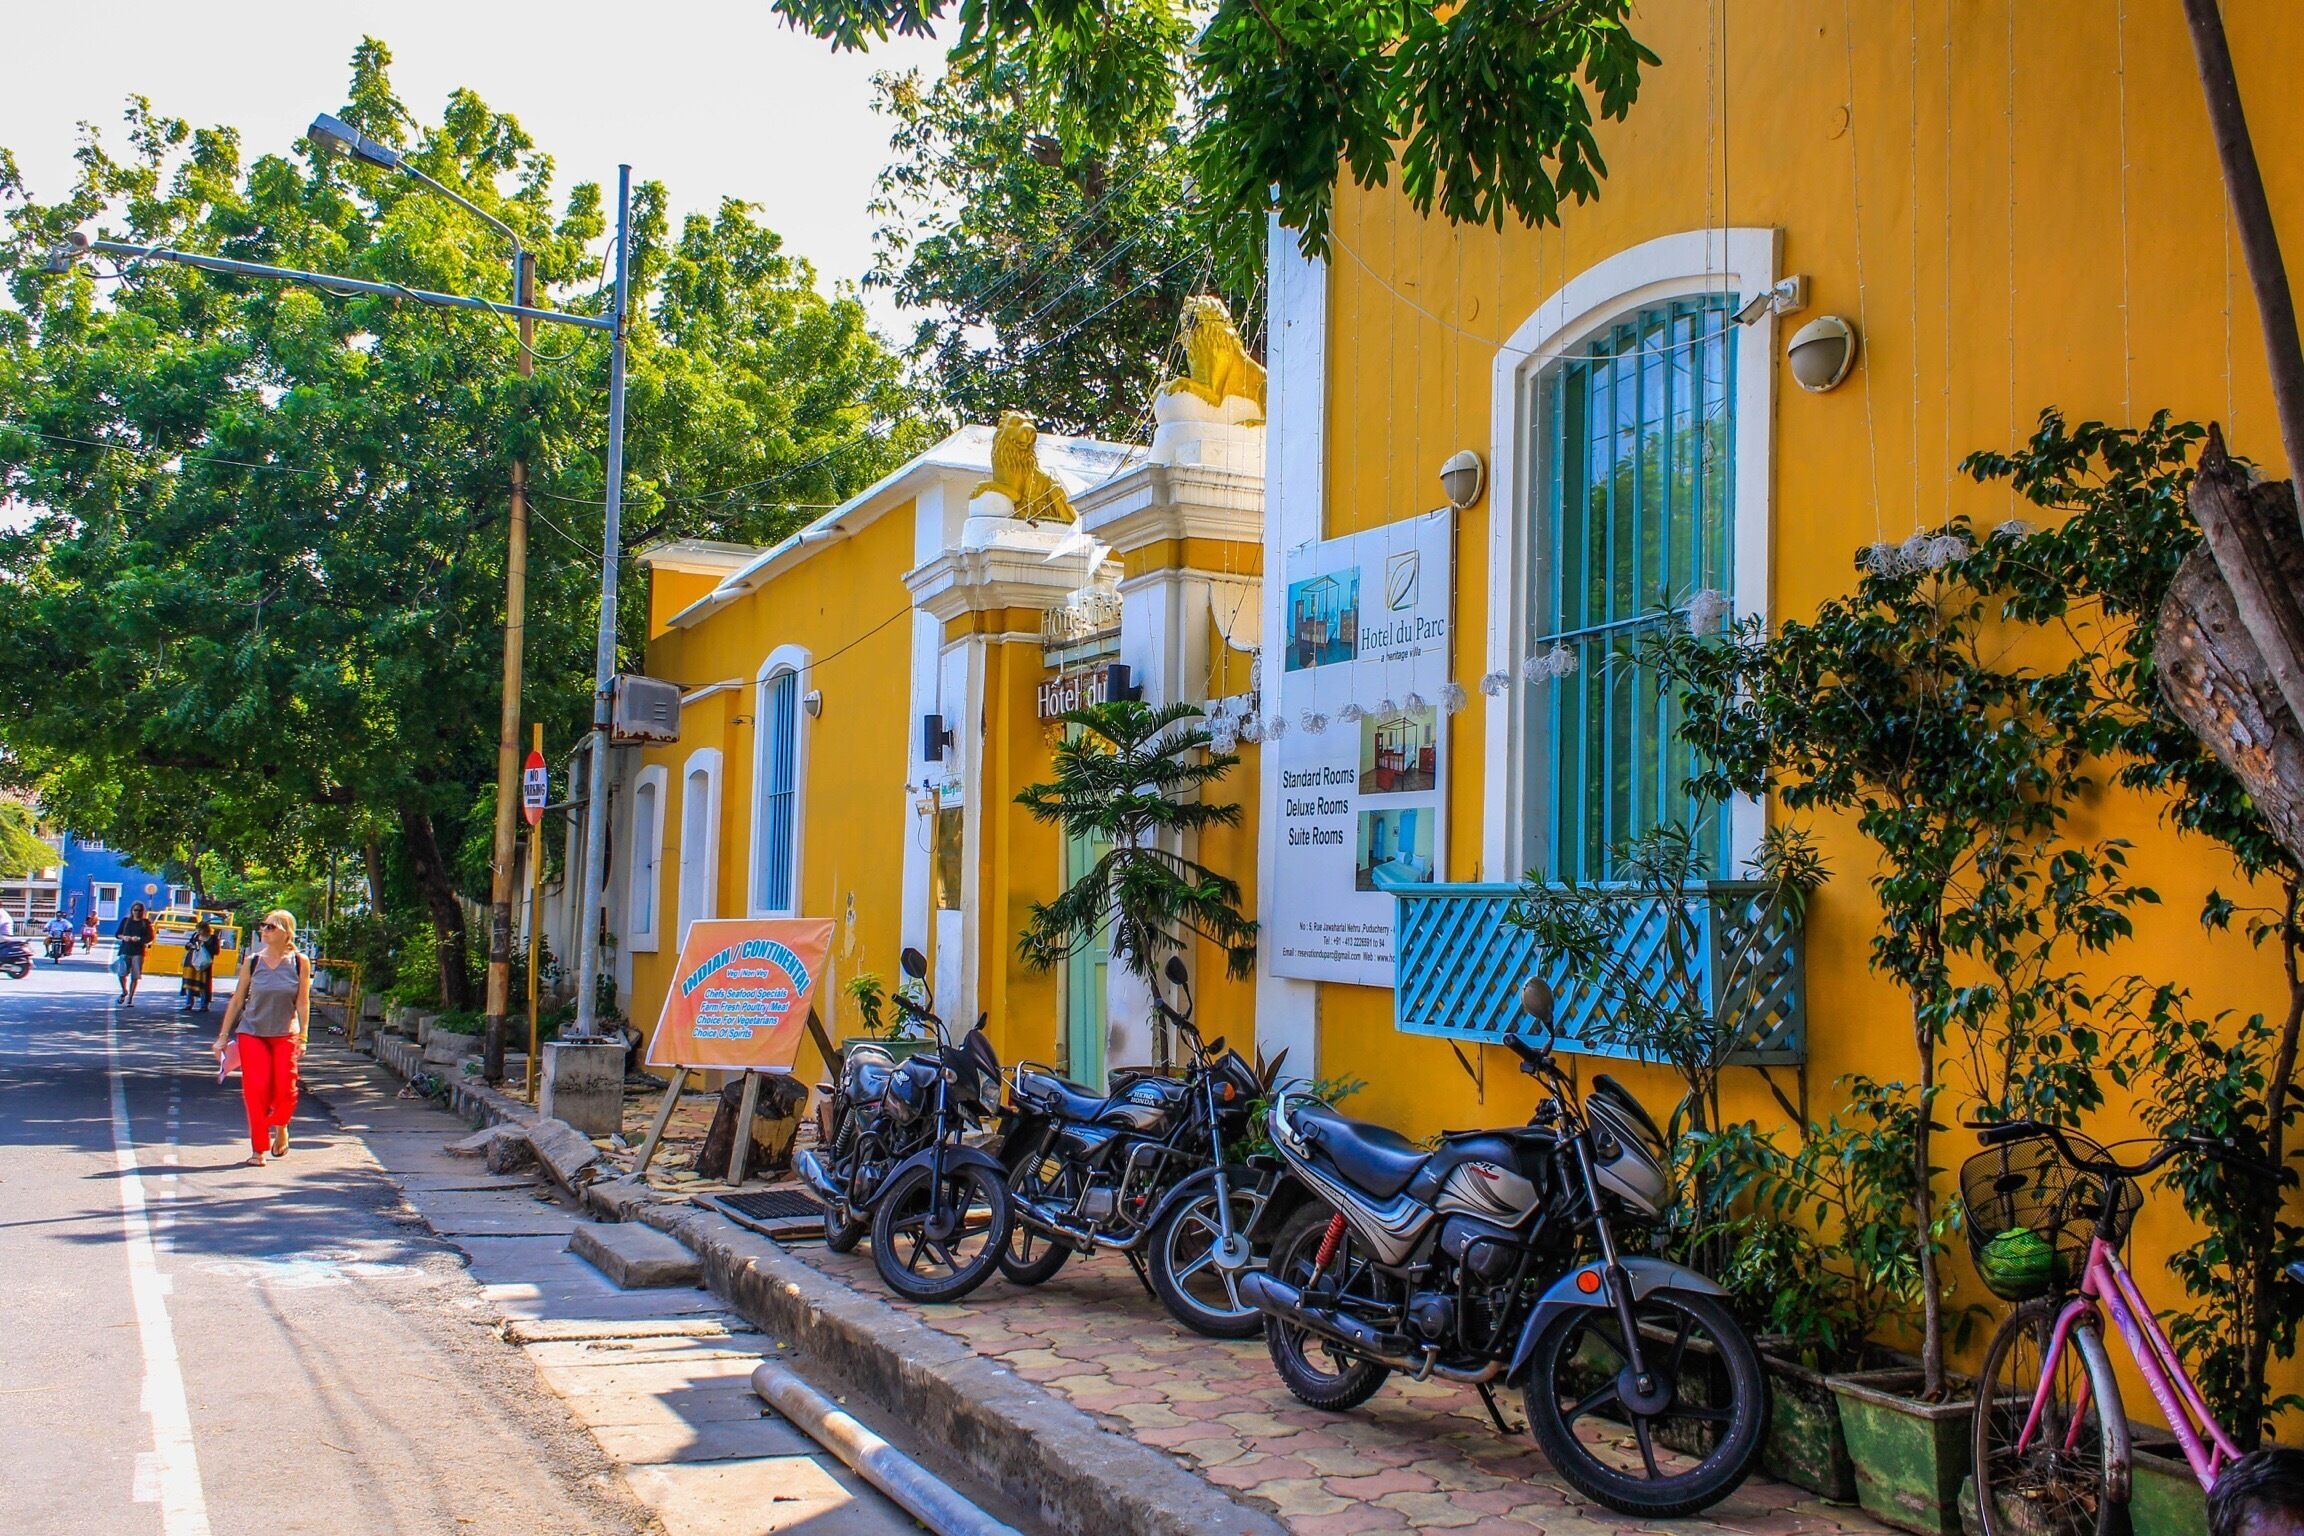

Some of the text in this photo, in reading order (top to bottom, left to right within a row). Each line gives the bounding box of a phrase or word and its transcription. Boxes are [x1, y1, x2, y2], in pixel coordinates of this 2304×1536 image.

[1361, 617, 1445, 651] Hotel du Parc
[1380, 646, 1421, 662] a heritage villa
[530, 768, 539, 782] NO
[1282, 766, 1355, 789] Standard Rooms
[524, 783, 546, 796] PARKING
[1286, 796, 1349, 817] Deluxe Rooms
[1288, 826, 1344, 846] Suite Rooms
[1313, 922, 1322, 931] Rue
[1347, 923, 1361, 932] Nehru
[1373, 938, 1378, 948] to
[1282, 947, 1294, 956] Email
[1362, 951, 1373, 961] Web
[682, 947, 731, 998] INDIAN
[741, 939, 811, 998] CONTINENTAL
[727, 969, 738, 979] Veg
[705, 988, 788, 1000] Chefs Seafood Specials
[701, 1001, 719, 1012] Farm
[720, 1001, 740, 1012] Fresh
[741, 1001, 767, 1014] Poultry
[696, 1015, 779, 1027] Choice For Vegetarians
[692, 1027, 753, 1040] Choice Of Spirits
[1130, 1097, 1155, 1106] HONDA
[1134, 1091, 1154, 1099] HERO
